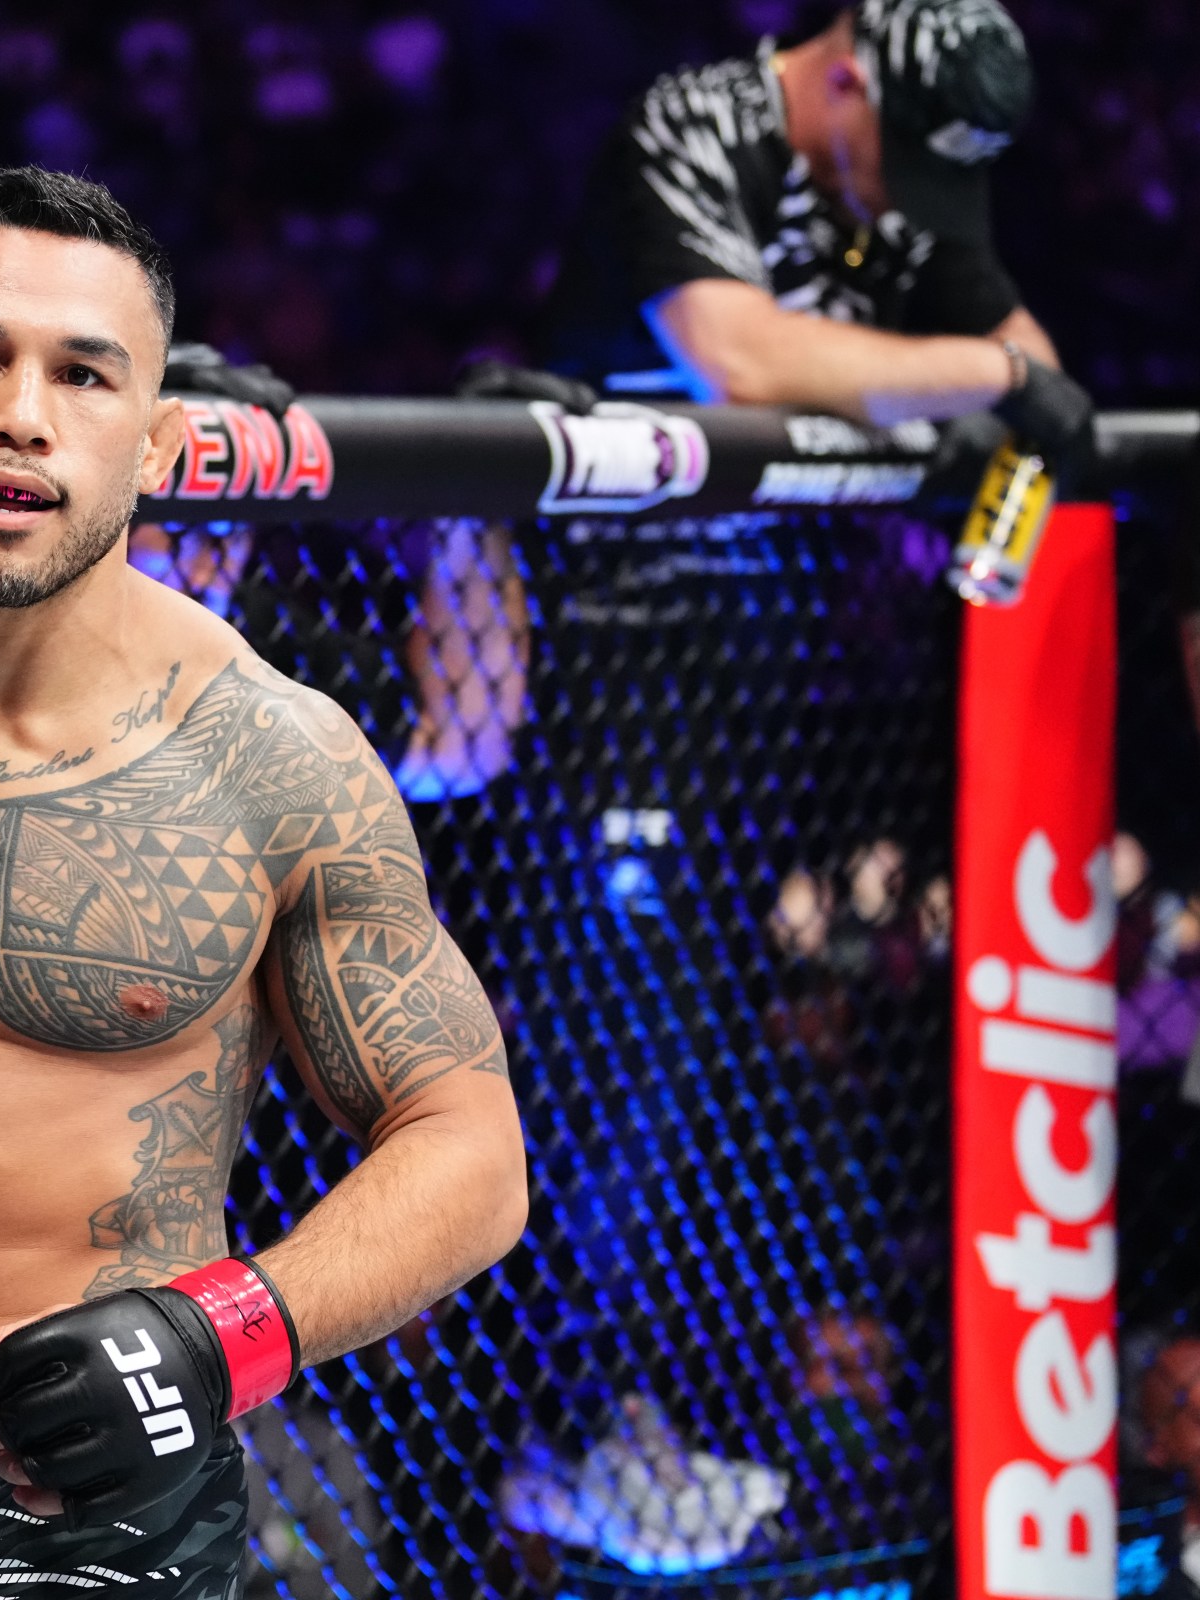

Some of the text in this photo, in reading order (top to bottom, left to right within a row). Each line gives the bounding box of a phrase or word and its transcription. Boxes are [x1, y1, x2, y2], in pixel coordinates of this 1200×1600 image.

[150, 400, 335, 499] ENA
[967, 828, 1118, 1599] Betclic
[100, 1328, 196, 1457] UFC
